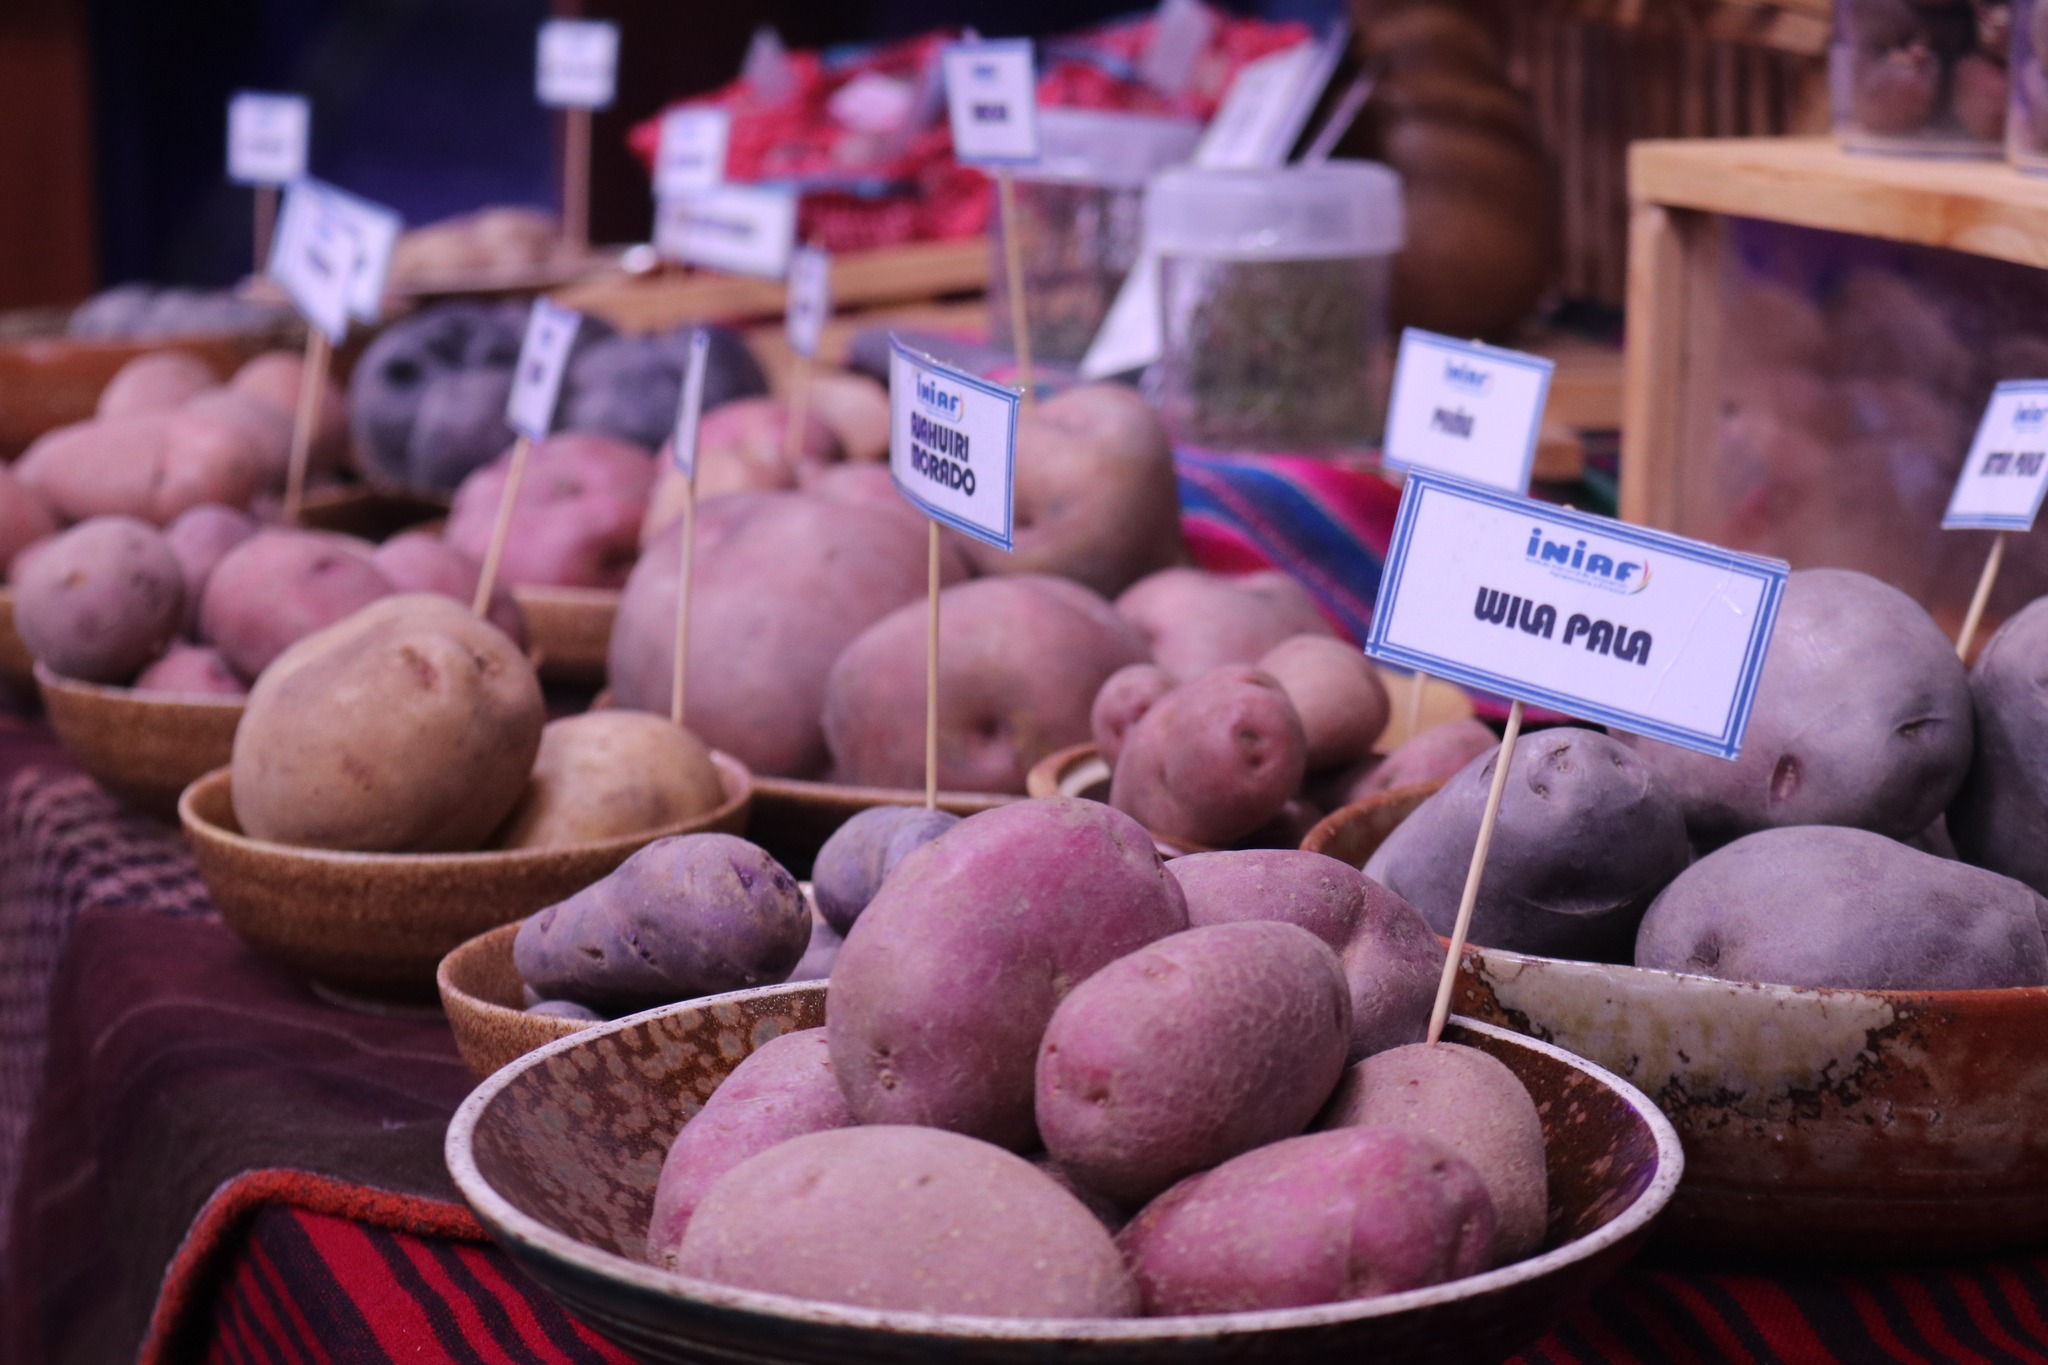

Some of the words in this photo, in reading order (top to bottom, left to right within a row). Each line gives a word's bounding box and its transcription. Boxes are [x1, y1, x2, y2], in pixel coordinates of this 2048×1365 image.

[912, 442, 976, 497] MORADO
[1473, 586, 1557, 640] WILA
[1562, 613, 1653, 666] PALA
